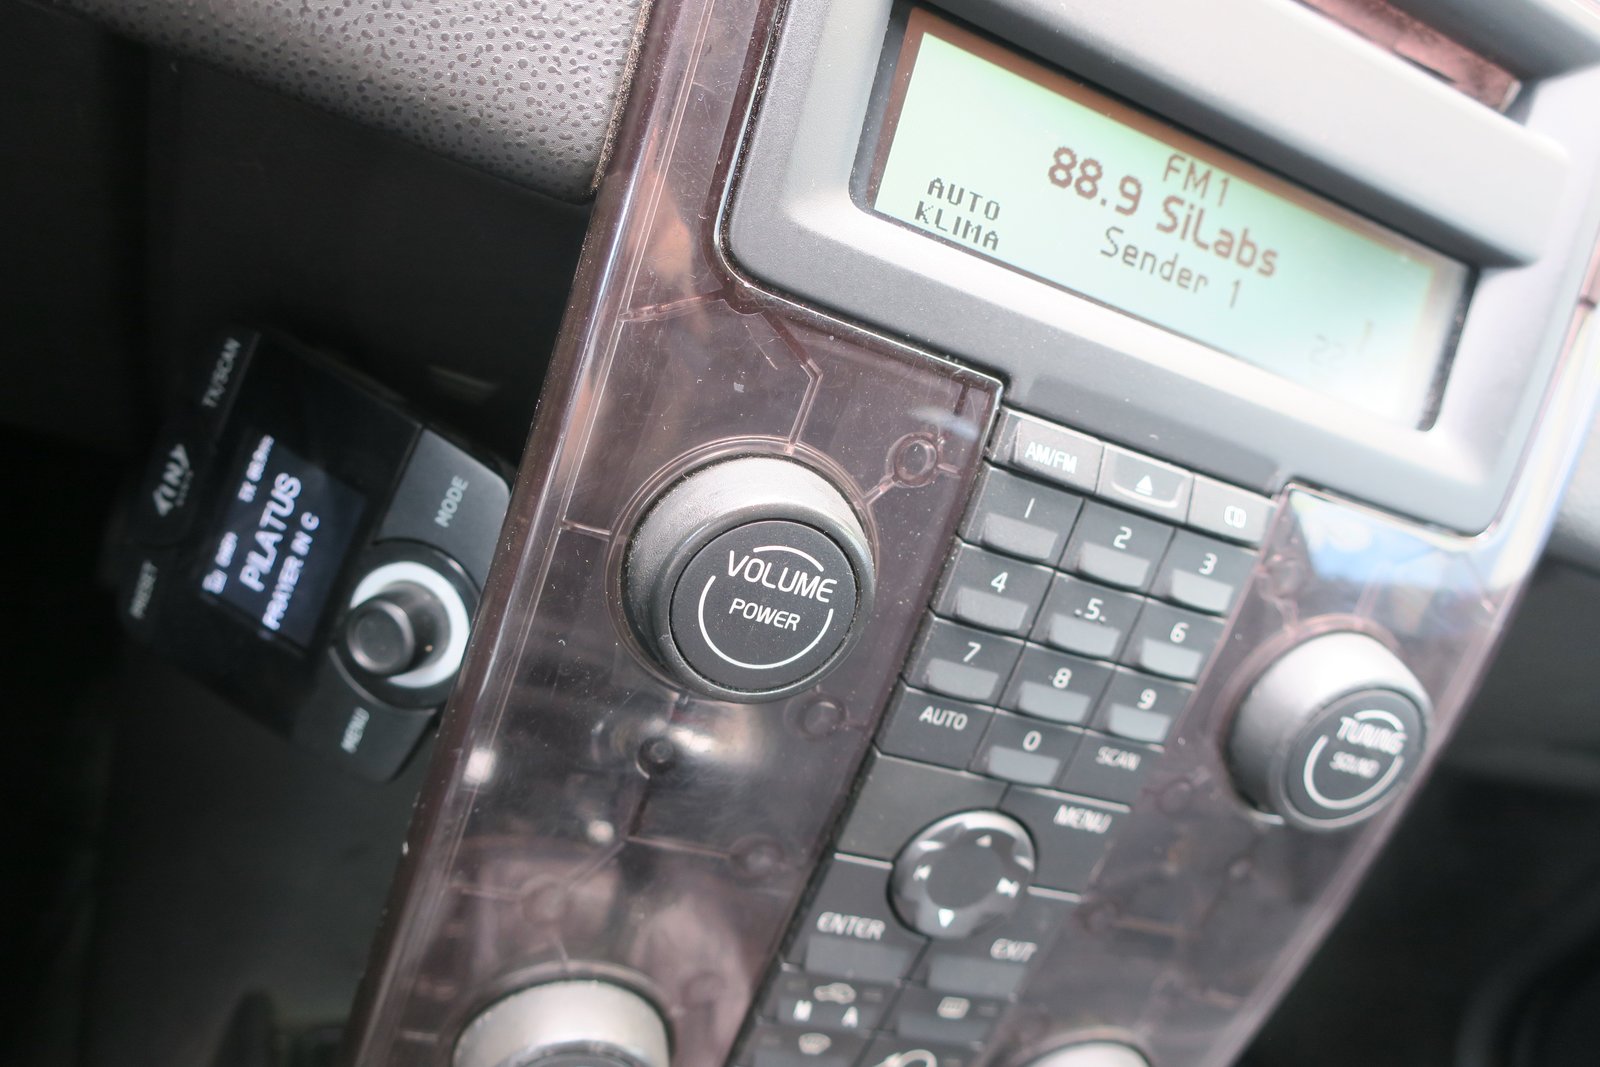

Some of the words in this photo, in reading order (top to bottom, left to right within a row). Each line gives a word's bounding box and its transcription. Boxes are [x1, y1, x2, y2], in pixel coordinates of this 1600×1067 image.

[926, 176, 1001, 222] AUTO
[1047, 146, 1144, 217] 88.9
[1156, 194, 1279, 278] SiLabs
[914, 201, 1000, 252] KLIMA
[1100, 227, 1209, 295] Sender
[1230, 279, 1243, 309] 1
[1025, 442, 1078, 474] AM/FM
[434, 474, 469, 528] MODE
[1023, 497, 1036, 518] 1
[301, 511, 320, 531] C
[1113, 526, 1132, 549] 2
[727, 550, 838, 603] VOLUME
[1198, 552, 1218, 575] 3
[990, 571, 1009, 593] 4
[729, 598, 801, 632] POWER
[1169, 621, 1189, 643] 6
[963, 641, 981, 663] 7
[1052, 667, 1072, 689] 8
[1137, 688, 1156, 710] 9
[341, 707, 370, 753] MENU
[919, 705, 968, 732] AUTO
[1021, 729, 1042, 752] 0
[1337, 716, 1408, 755] TUNING
[1095, 746, 1142, 772] SCAN
[1053, 804, 1113, 834] MENU
[816, 911, 886, 940] ENTER
[990, 938, 1037, 962] EXIT
